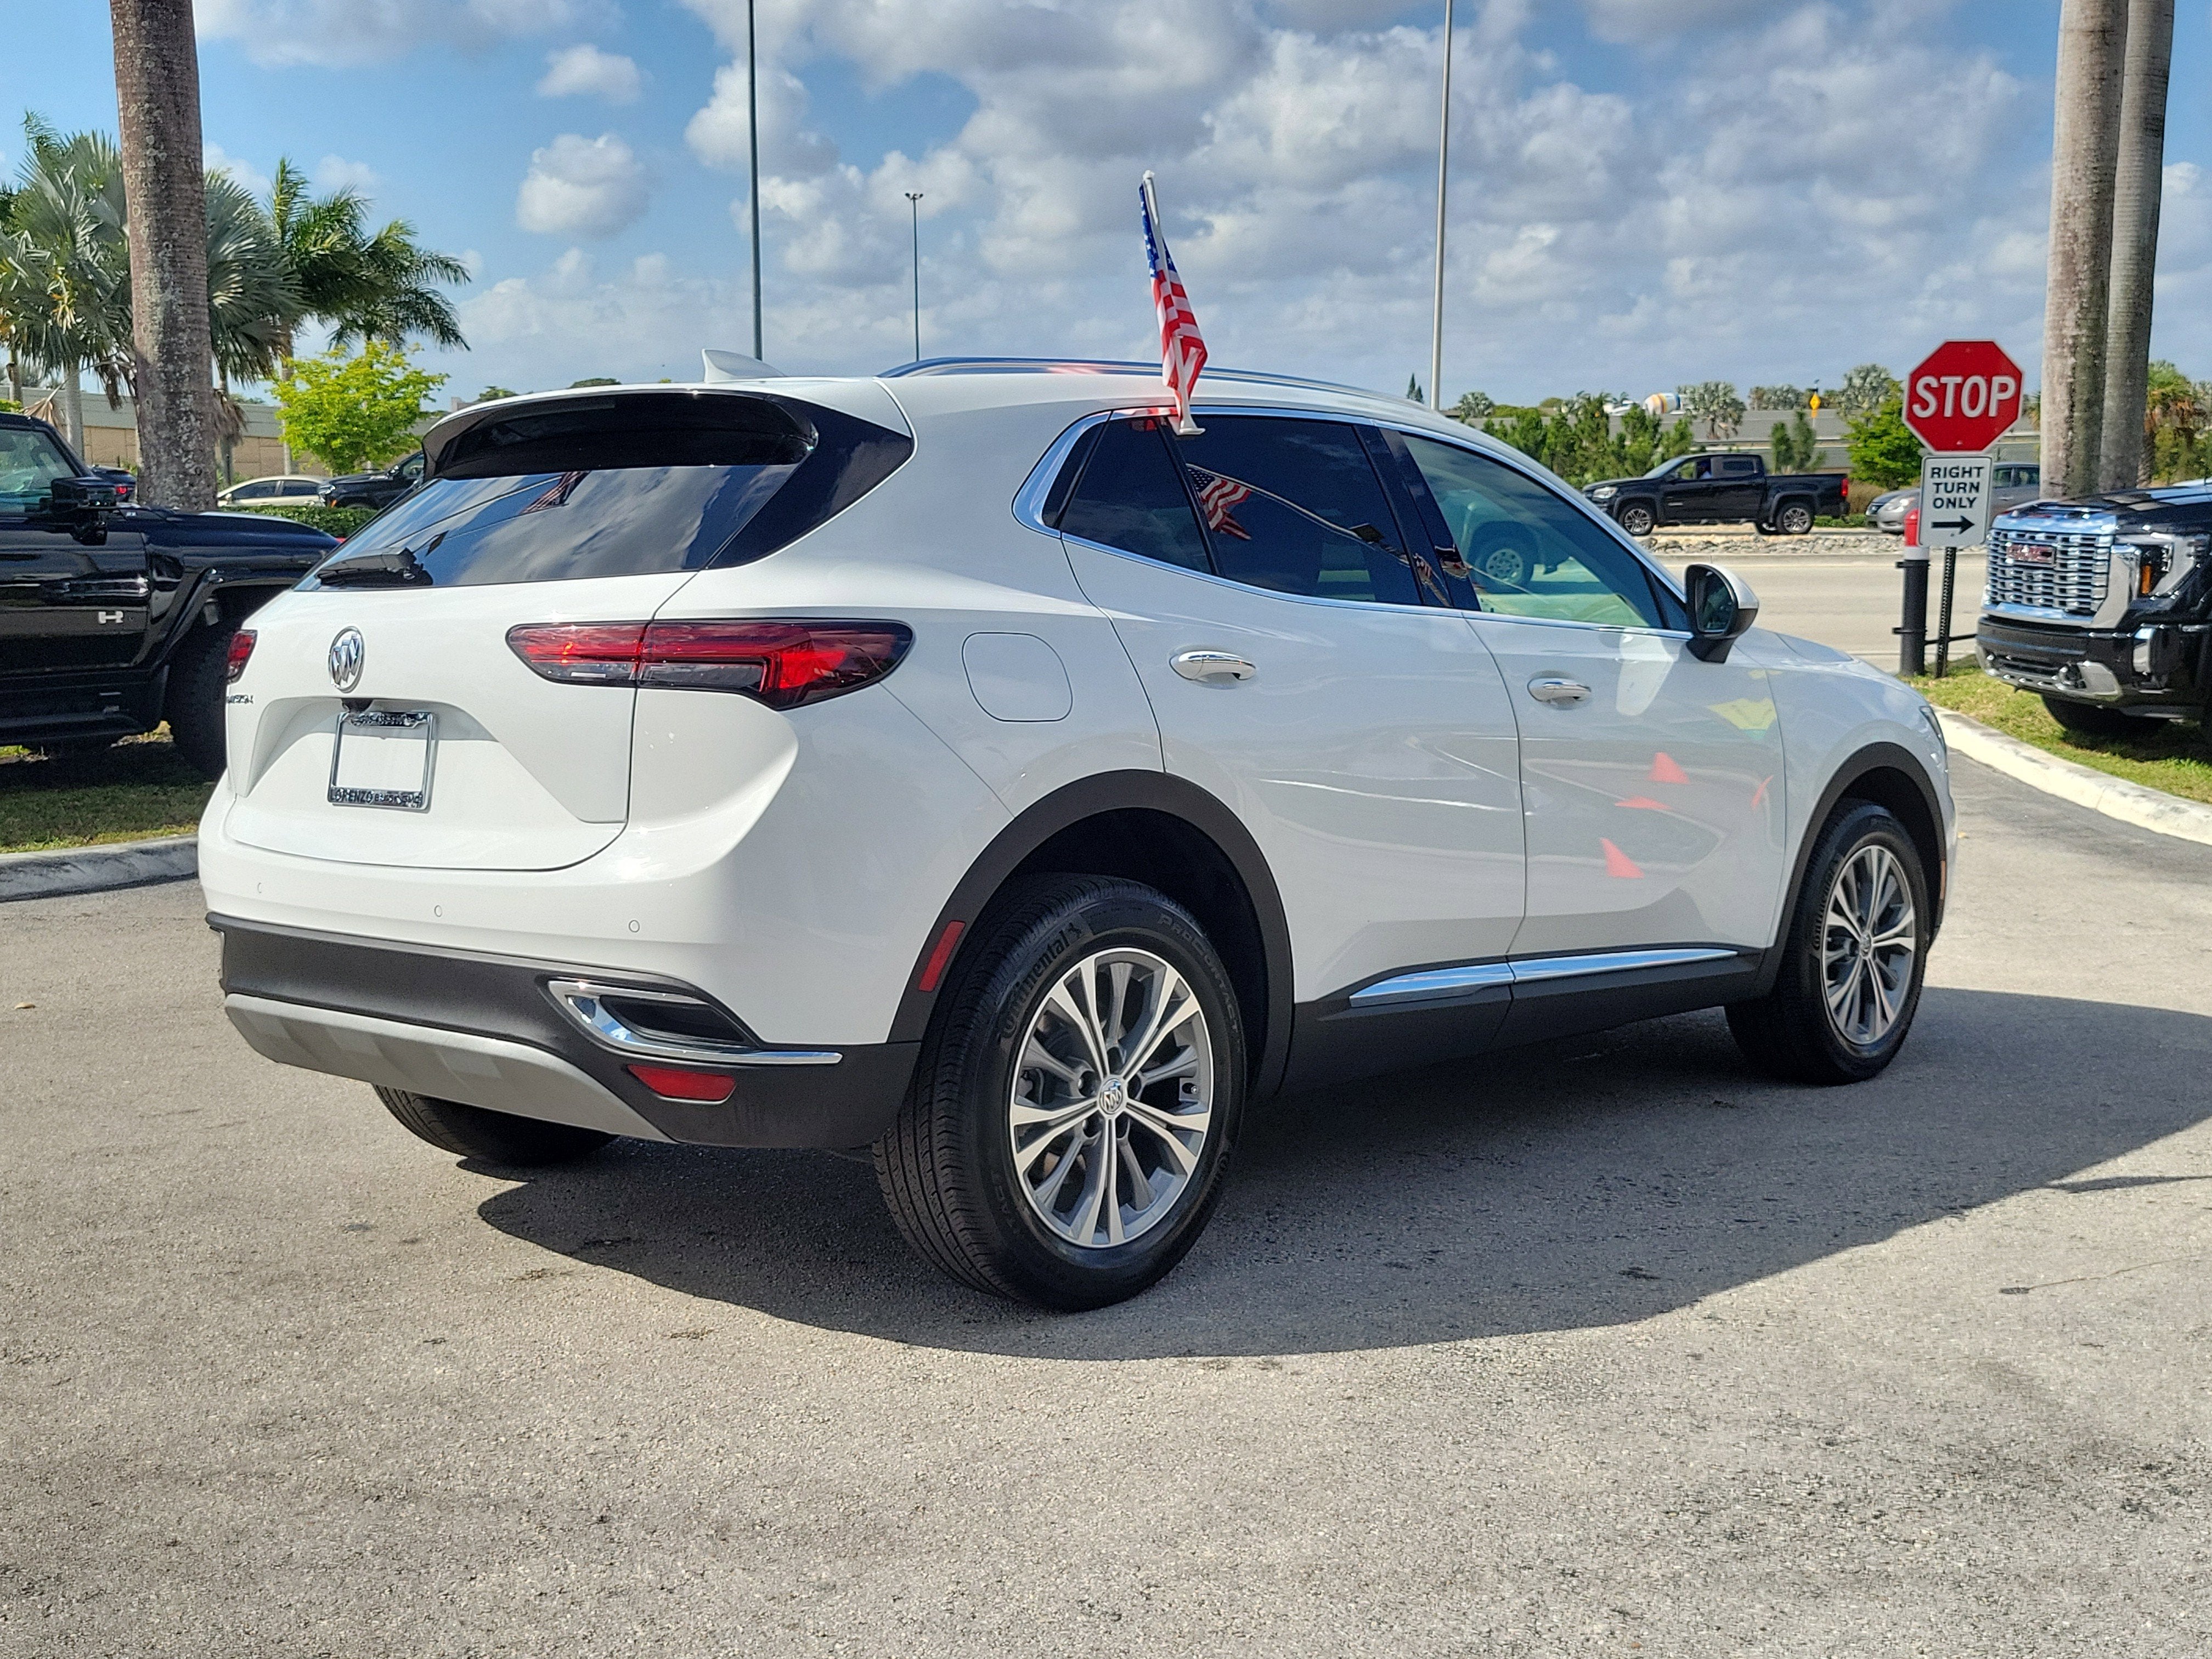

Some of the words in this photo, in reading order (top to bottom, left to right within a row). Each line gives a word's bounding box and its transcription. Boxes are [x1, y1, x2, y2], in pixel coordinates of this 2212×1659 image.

[1912, 375, 2017, 418] STOP
[1931, 466, 1984, 478] RIGHT
[1932, 481, 1980, 494] TURN
[1933, 496, 1977, 509] ONLY
[330, 788, 373, 803] LORENZO
